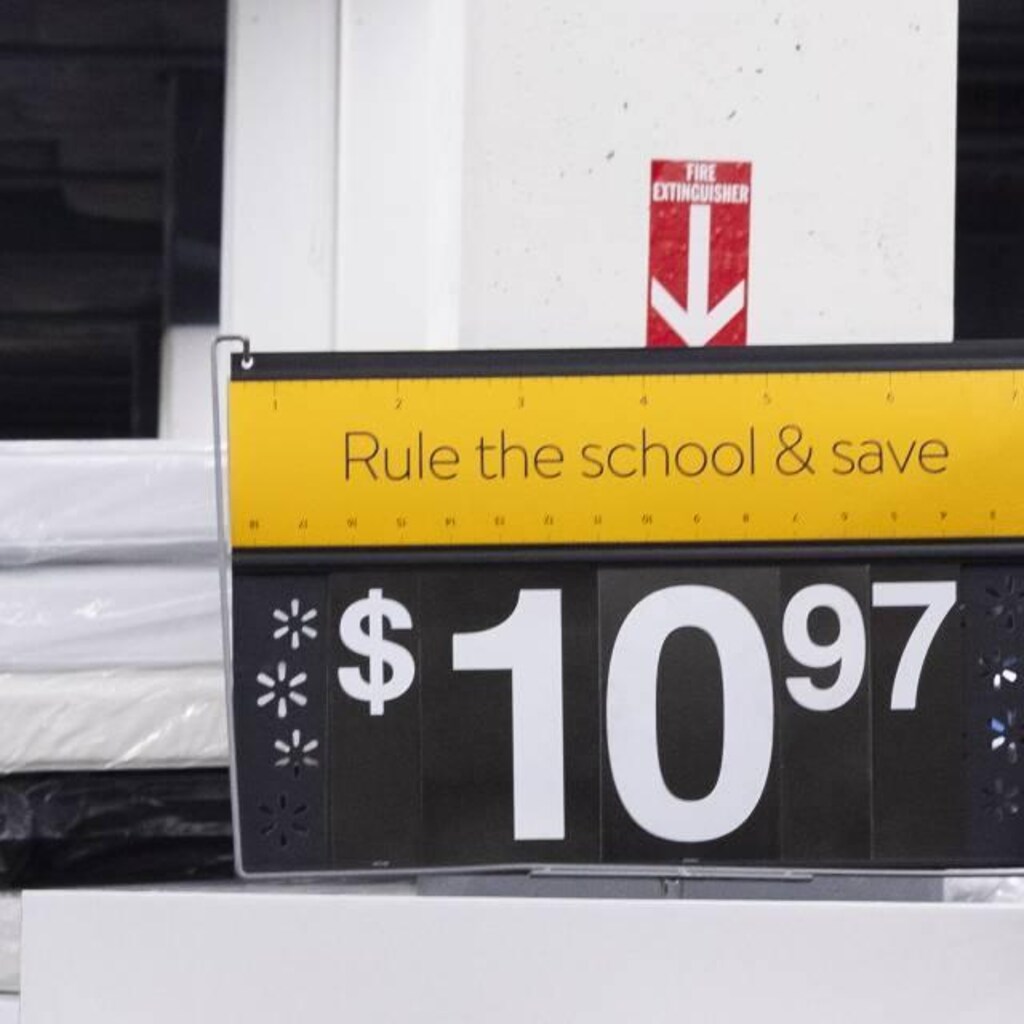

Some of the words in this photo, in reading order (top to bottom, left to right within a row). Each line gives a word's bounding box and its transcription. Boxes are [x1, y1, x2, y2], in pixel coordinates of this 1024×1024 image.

[686, 163, 716, 182] FIRE
[652, 182, 750, 204] EXTINGUISHER
[344, 430, 460, 481] Rule
[475, 429, 565, 480] the
[581, 425, 755, 480] school
[775, 424, 815, 477] &
[831, 438, 950, 475] save
